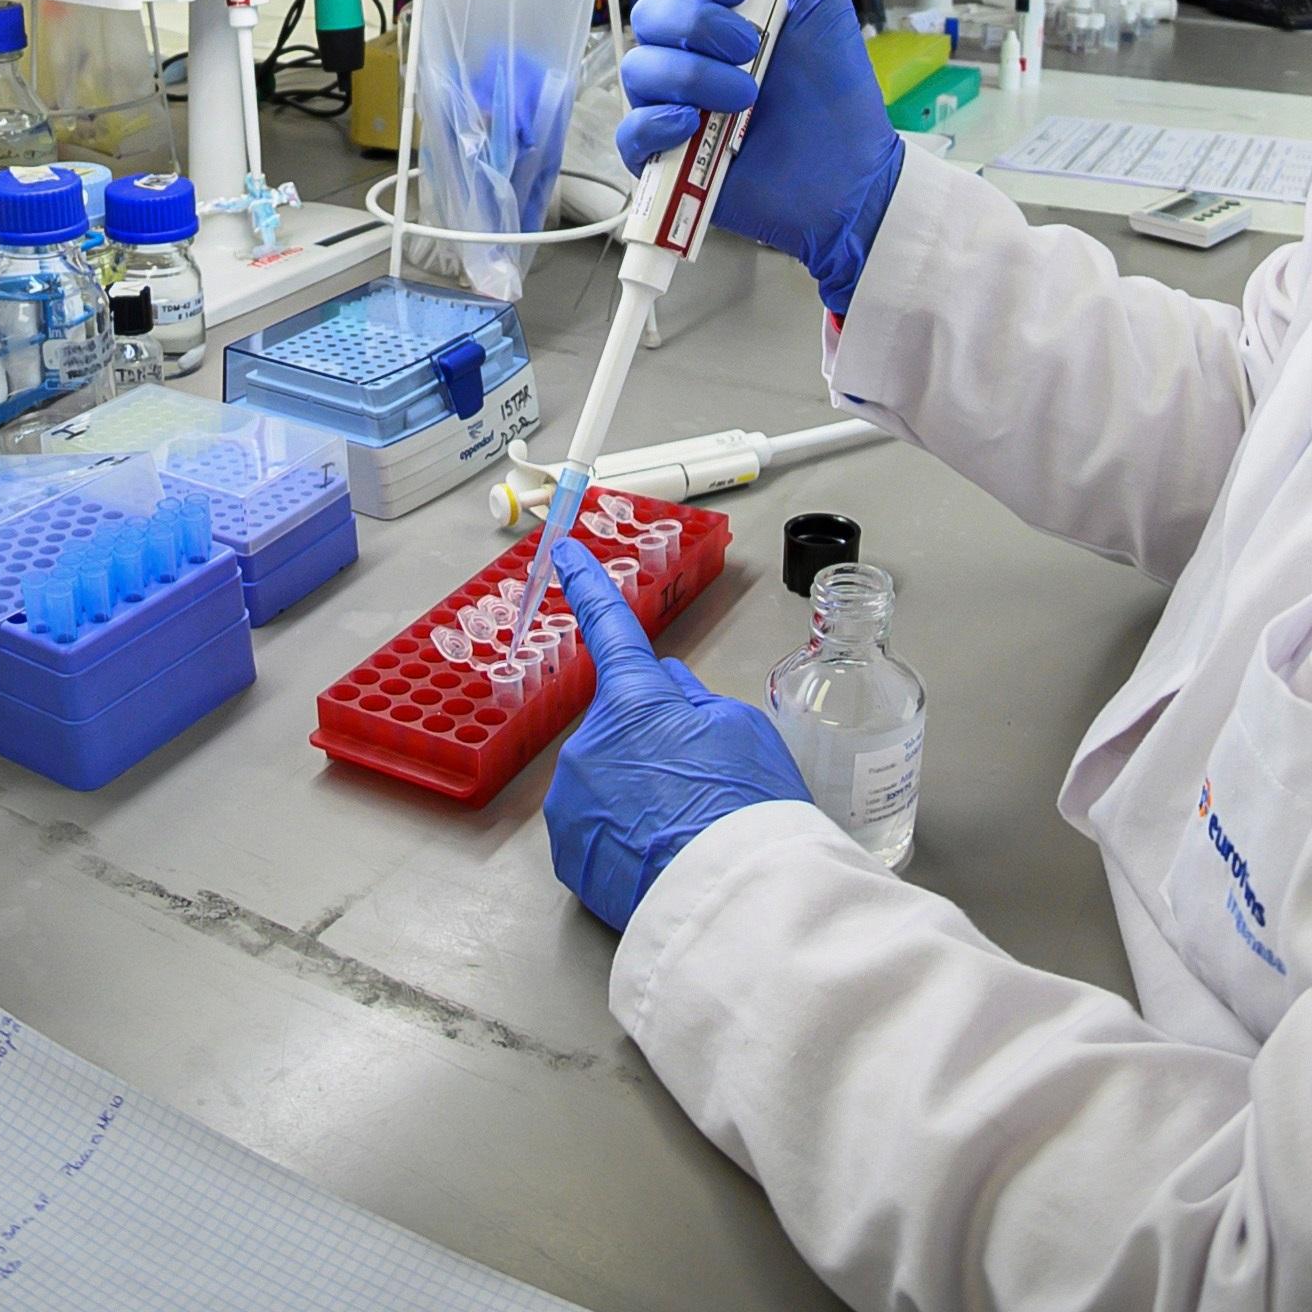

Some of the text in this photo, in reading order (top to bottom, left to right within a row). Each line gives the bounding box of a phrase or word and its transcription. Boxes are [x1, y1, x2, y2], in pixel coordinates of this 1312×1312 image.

[500, 384, 532, 421] ISTAR
[459, 429, 494, 461] eppendorf
[1208, 812, 1266, 928] eurofins
